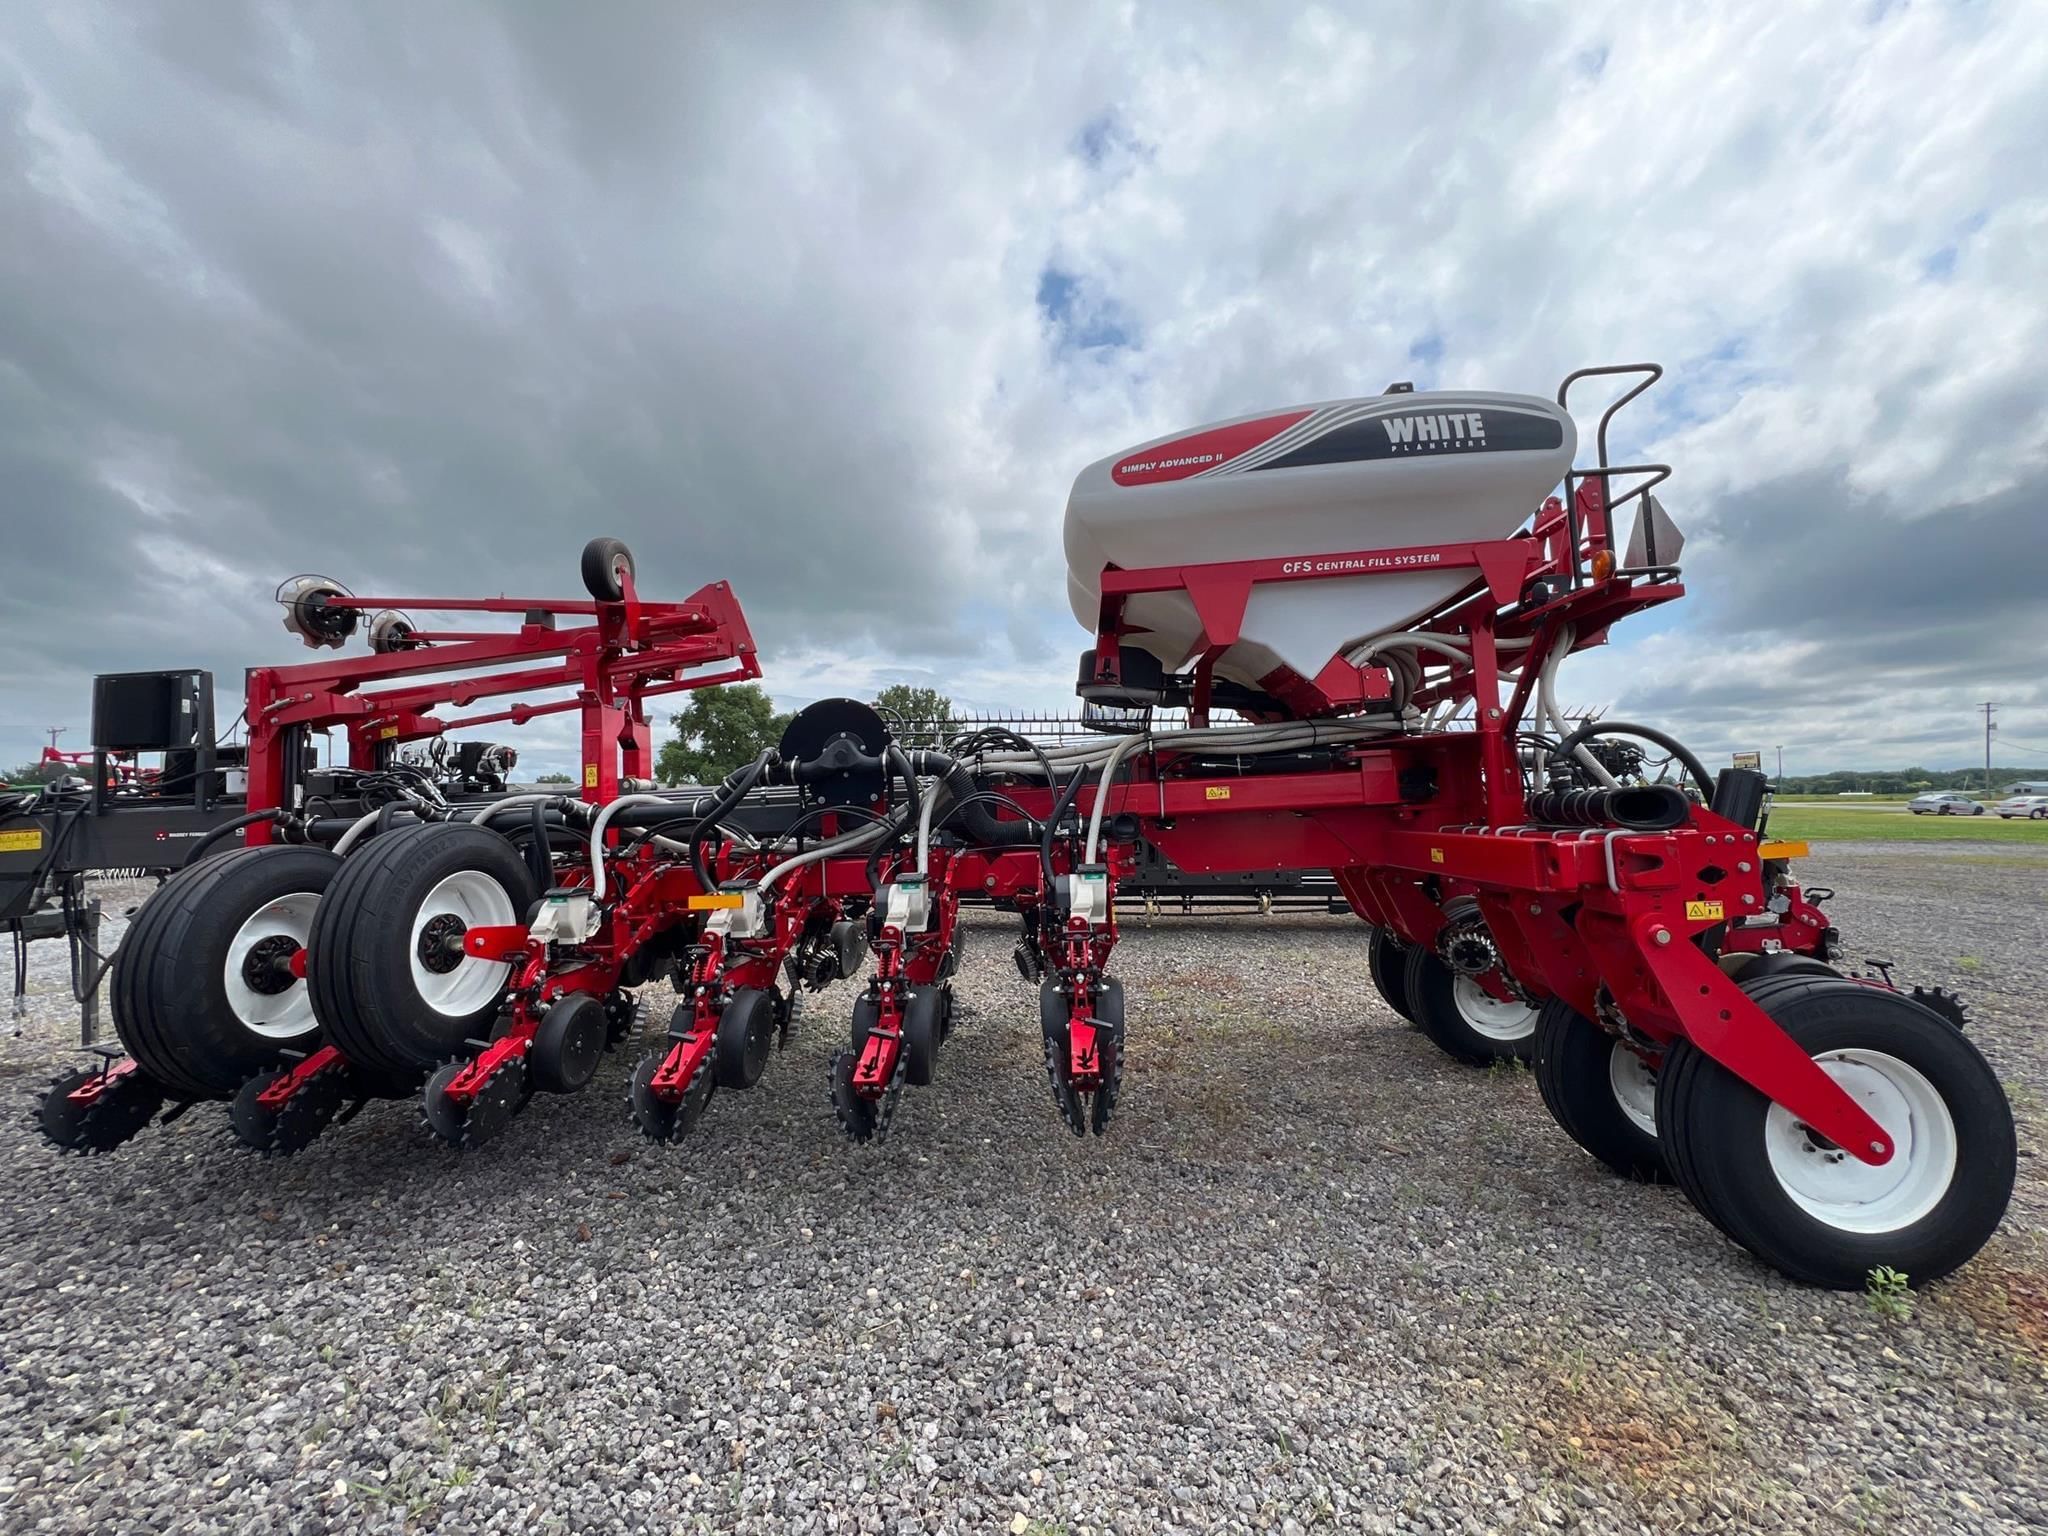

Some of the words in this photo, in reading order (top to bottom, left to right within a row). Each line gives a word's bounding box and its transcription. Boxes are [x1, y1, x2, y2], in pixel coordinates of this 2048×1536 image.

[1381, 413, 1485, 443] WHITE
[1391, 440, 1486, 452] PLANTERS
[1121, 462, 1157, 474] SIMPLY
[1159, 454, 1213, 469] ADVANCED
[1215, 453, 1223, 462] II
[1283, 561, 1312, 574] CFS
[1316, 559, 1365, 571] CENTRAL
[1368, 557, 1392, 567] FILL
[1394, 553, 1440, 564] SYSTEM
